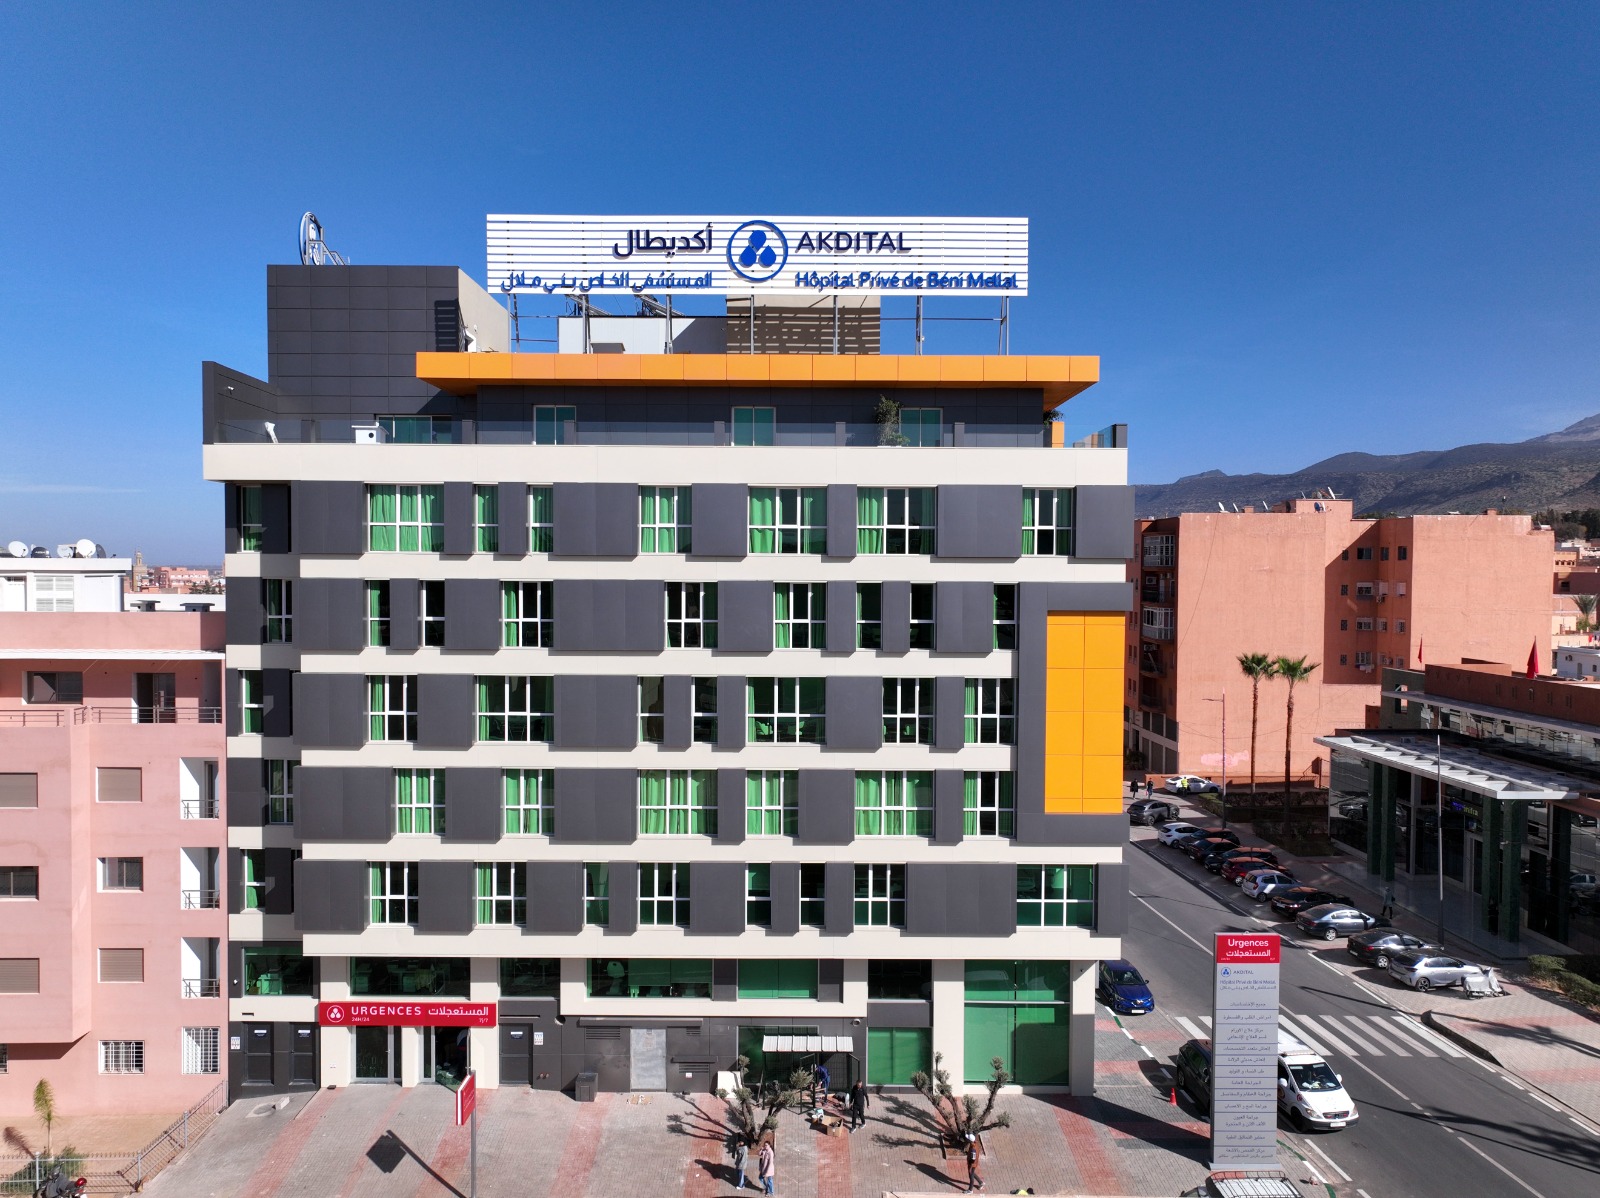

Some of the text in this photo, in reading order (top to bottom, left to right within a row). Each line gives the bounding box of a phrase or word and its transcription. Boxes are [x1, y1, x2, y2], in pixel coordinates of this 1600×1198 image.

[614, 222, 713, 258] أكديطال
[796, 231, 912, 252] AKDITAL
[500, 270, 541, 293] ملال
[579, 270, 630, 293] الخاص
[632, 270, 712, 293] المستشفى
[795, 270, 1018, 293] Hôpital Privé de Béni Mellal
[1225, 949, 1271, 958] المستعجلات
[1228, 938, 1269, 949] Urgences
[351, 1006, 421, 1016] URGENCES
[428, 1006, 489, 1018] المستعجلات
